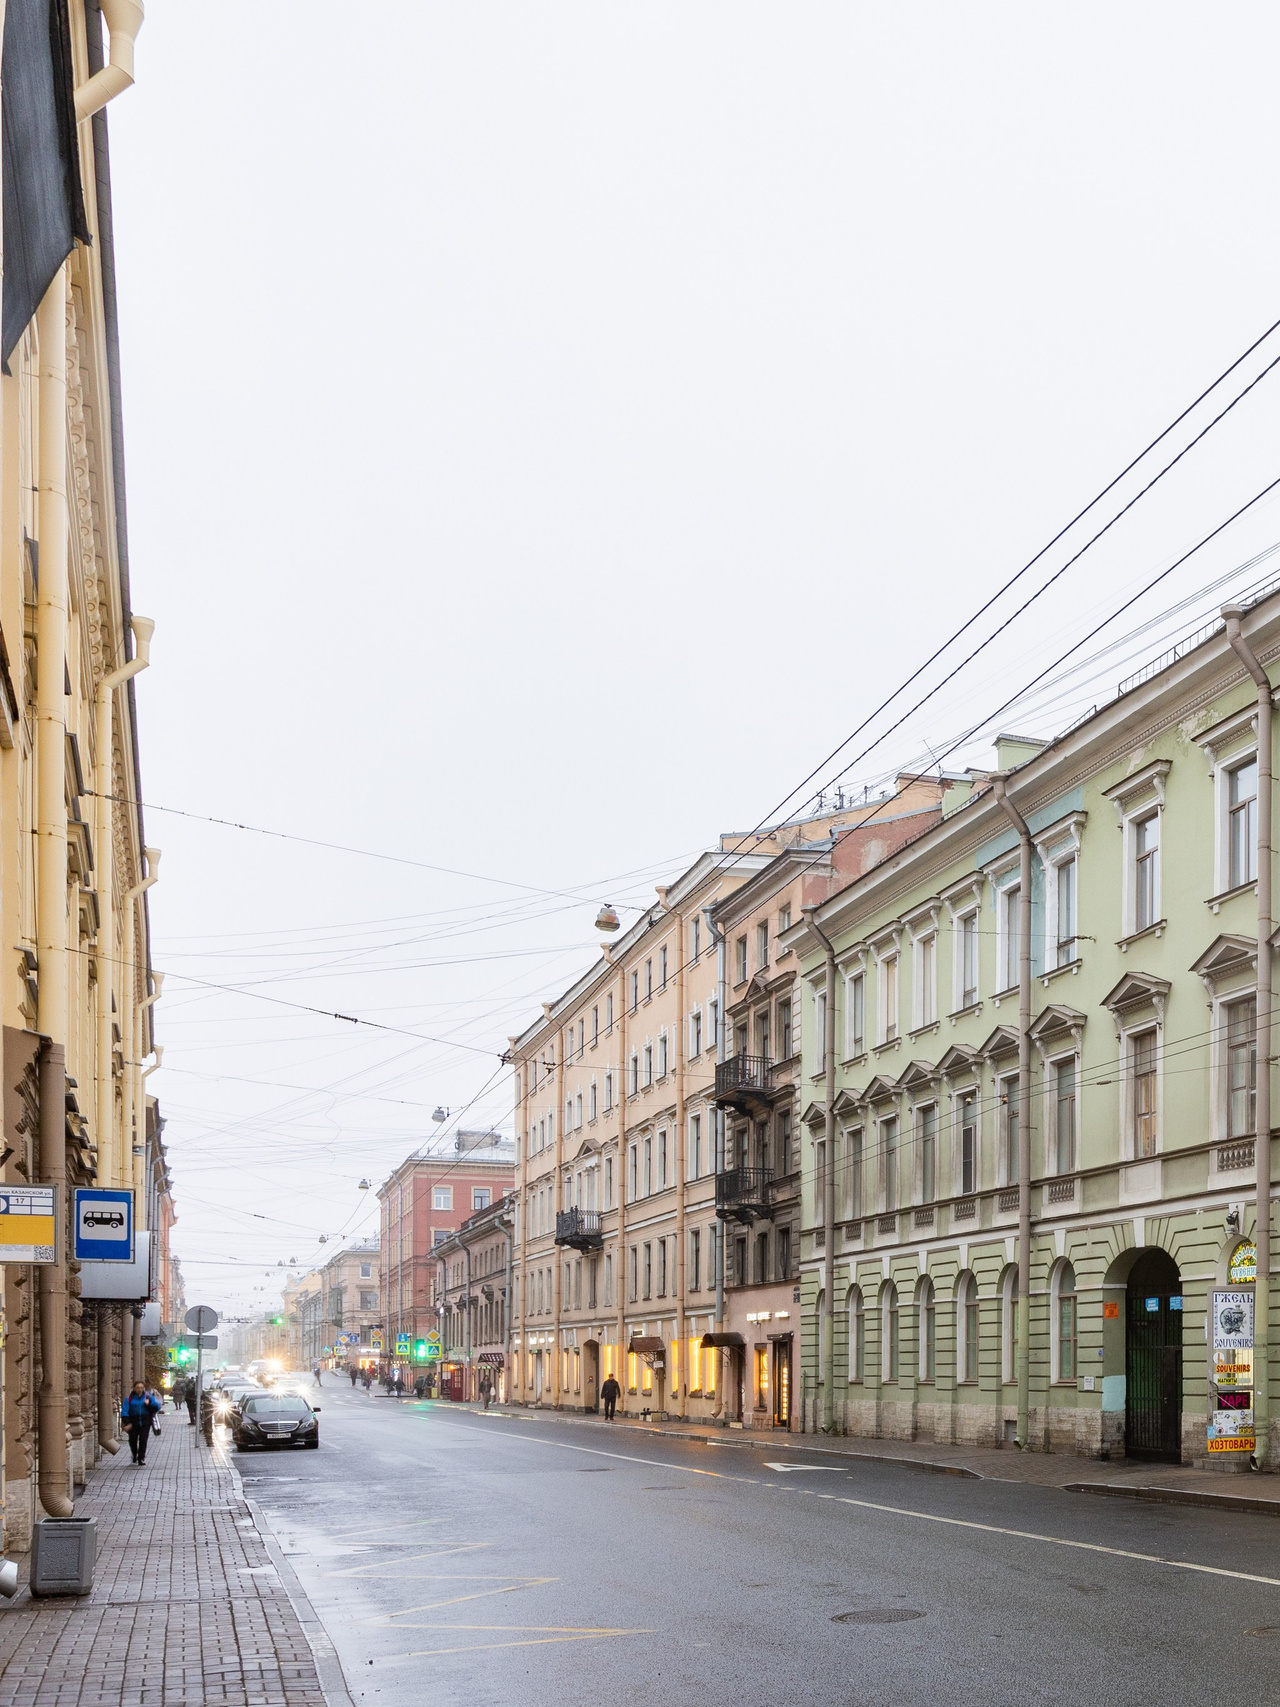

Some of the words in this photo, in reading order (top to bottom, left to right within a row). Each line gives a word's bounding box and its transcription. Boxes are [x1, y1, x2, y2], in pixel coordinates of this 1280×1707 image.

[1234, 1246, 1257, 1263] ПОДАР
[1231, 1266, 1257, 1278] СУВЕНИ
[1214, 1338, 1254, 1348] SOUVENIRS
[1216, 1364, 1251, 1373] SOUVENIRS
[1219, 1394, 1248, 1408] VAPE
